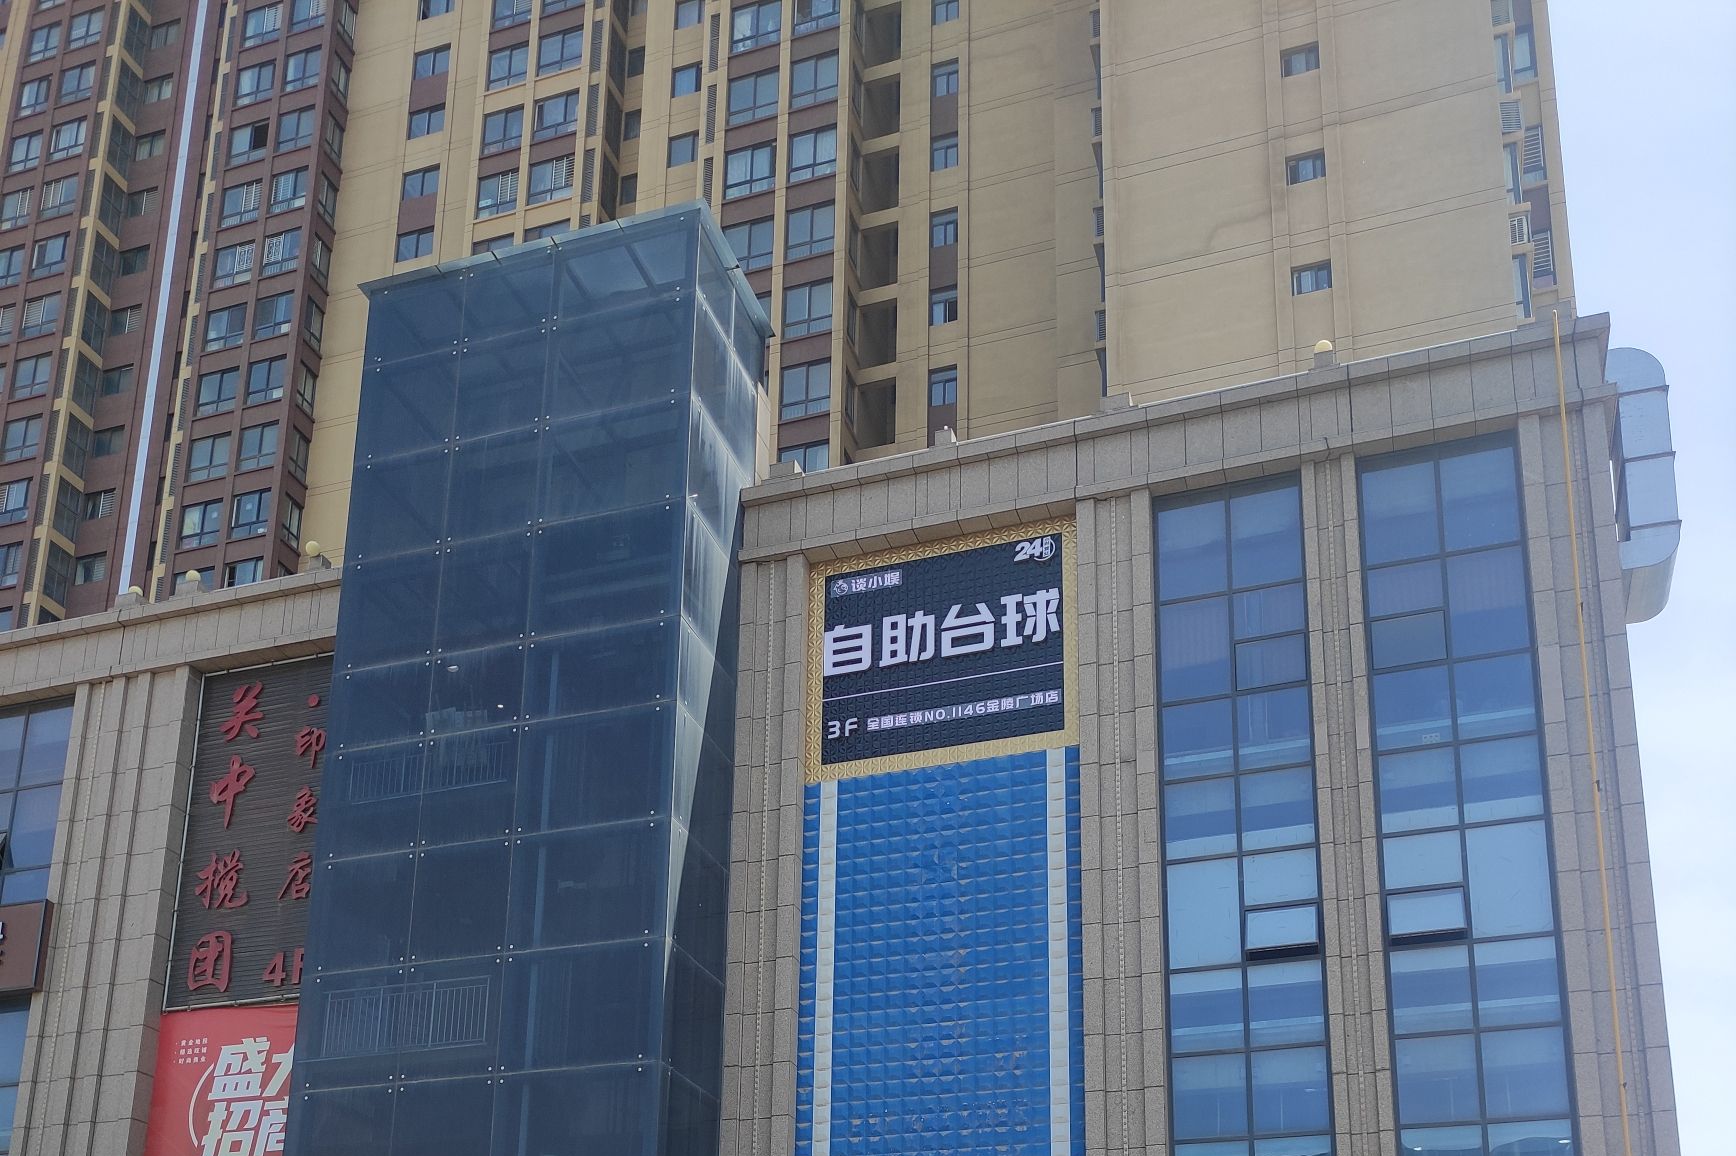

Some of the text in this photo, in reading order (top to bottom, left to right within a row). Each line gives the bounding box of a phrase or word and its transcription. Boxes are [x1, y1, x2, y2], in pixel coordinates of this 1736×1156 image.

[851, 571, 900, 592] 谈小娱
[823, 587, 1061, 677] 自助台球
[827, 717, 858, 739] 3F
